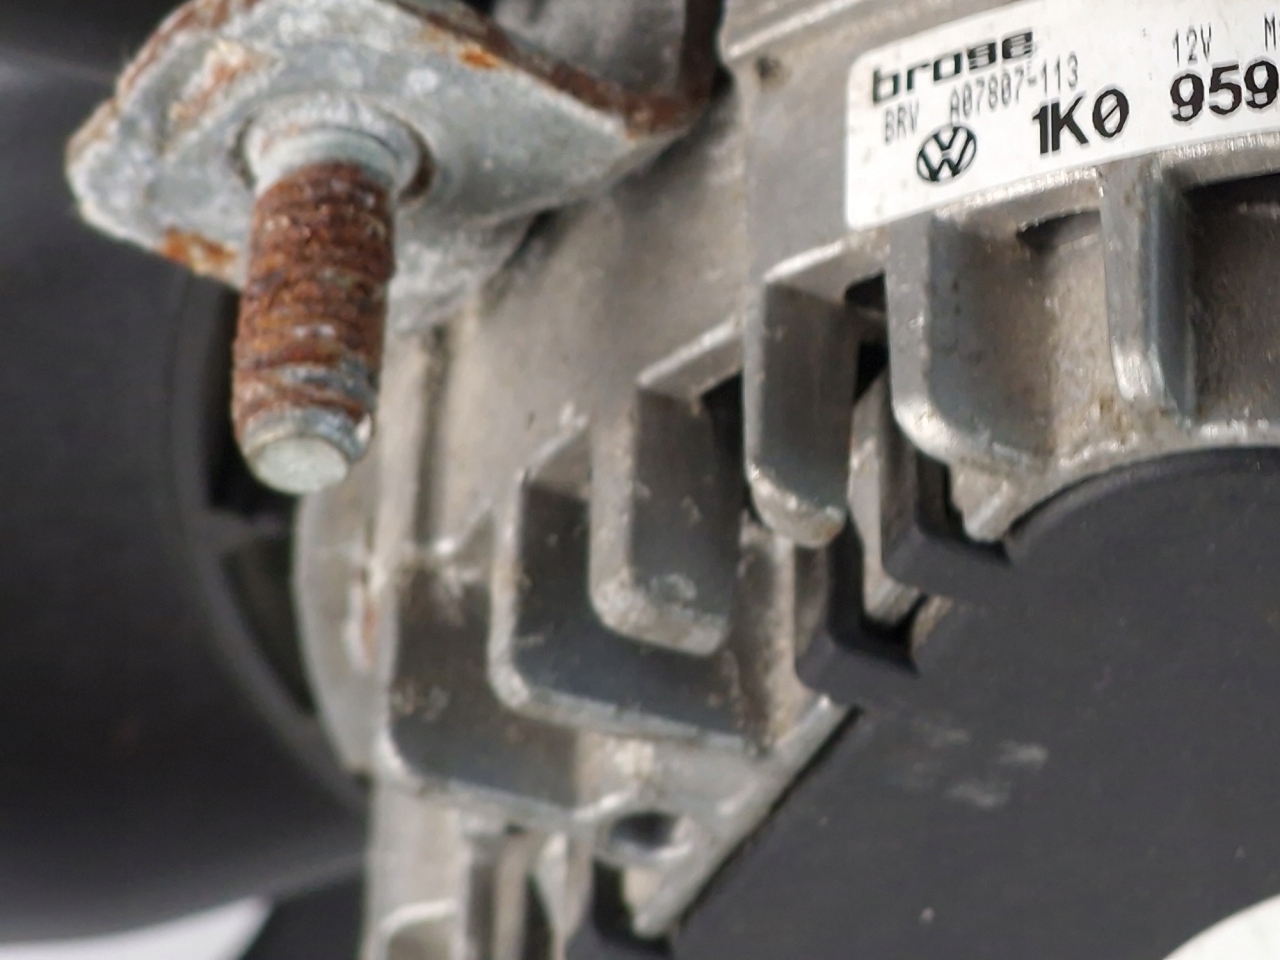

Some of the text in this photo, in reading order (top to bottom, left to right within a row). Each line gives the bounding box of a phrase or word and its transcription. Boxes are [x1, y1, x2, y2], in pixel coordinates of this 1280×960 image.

[873, 26, 1033, 104] brose
[1171, 23, 1212, 65] 12V
[884, 50, 1079, 144] BRV A07807-113
[1032, 86, 1130, 156] 1K0
[1170, 58, 1280, 122] 959
